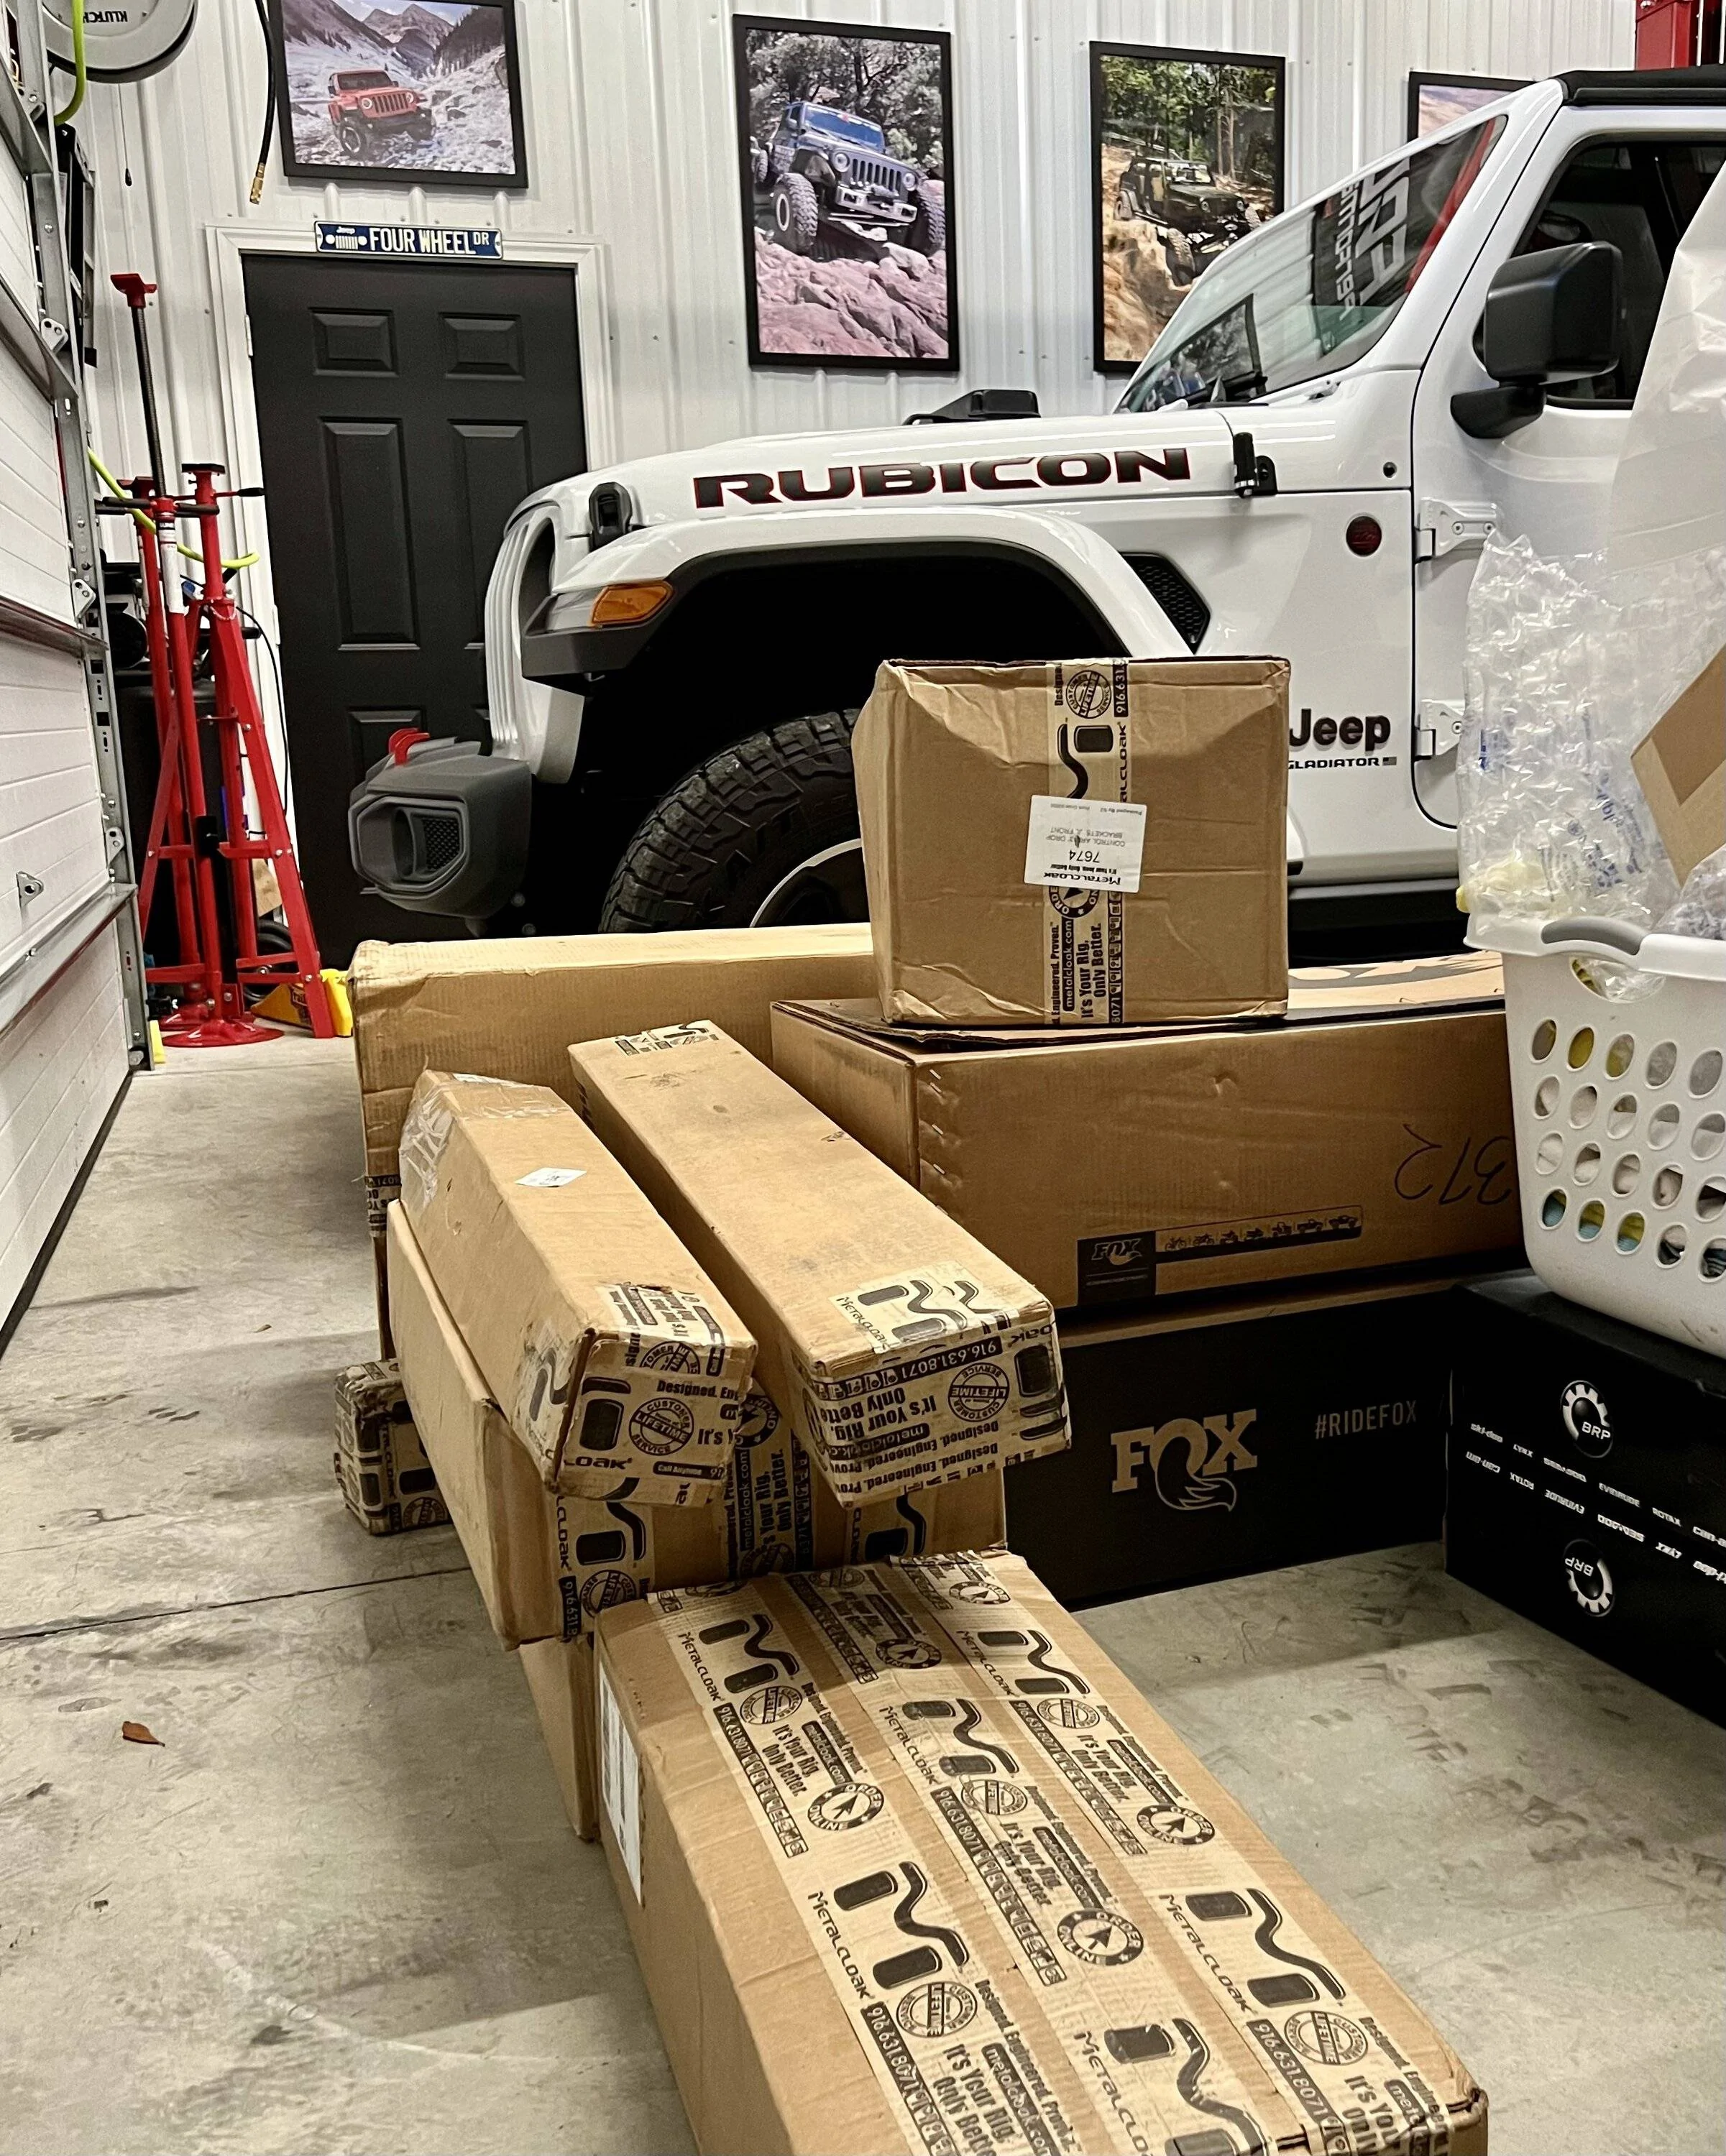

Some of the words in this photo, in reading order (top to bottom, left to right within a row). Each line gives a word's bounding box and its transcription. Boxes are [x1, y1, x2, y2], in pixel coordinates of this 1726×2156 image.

[369, 227, 415, 252] FOUR
[418, 229, 477, 255] WHEEL
[473, 232, 490, 246] DR
[692, 447, 1191, 509] RUBICON
[1289, 707, 1391, 752] Jeep
[1086, 829, 1123, 839] BRACKETS
[1093, 838, 1126, 847] CONTROL
[1069, 849, 1101, 863] 7674
[1075, 940, 1090, 965] Rig,
[1090, 922, 1104, 967] Better.
[1062, 920, 1073, 1008] metalcloak.com
[1078, 967, 1092, 997] Your
[1092, 969, 1107, 998] Only
[1080, 998, 1094, 1018] It's
[1091, 1238, 1143, 1264] FOX
[901, 1340, 997, 1379] 916.631.8071
[962, 1366, 1003, 1378] SERVICE
[656, 1379, 717, 1398] Designed.
[866, 1386, 906, 1413] Only
[950, 1387, 1007, 1398] LIFETIME
[868, 1406, 909, 1432] Your
[909, 1394, 937, 1416] It's
[952, 1398, 1001, 1422] CUSTOMER
[635, 1411, 691, 1443] LIFETIME
[939, 1420, 999, 1447] Designed.
[1314, 1399, 1418, 1440] #RIDEFOX
[1582, 1421, 1611, 1439] BRP
[697, 1427, 724, 1445] It's
[868, 1439, 937, 1470] Engineered.
[937, 1442, 999, 1470] Designed.
[1111, 1408, 1258, 1510] FOX
[863, 1460, 937, 1492] Engineered.
[1510, 1471, 1535, 1491] ROTAX
[739, 1451, 753, 1550] metalcloak.com
[759, 1502, 775, 1537] Your
[1564, 1557, 1594, 1577] BRP
[772, 1723, 794, 1741] It's
[782, 1736, 811, 1760] Your
[805, 1724, 847, 1785] metalcloak.com
[761, 1743, 787, 1766] Only
[775, 1761, 809, 1797] Better.
[845, 1783, 883, 1810] ORDER
[808, 1804, 848, 1832] ONLINE
[867, 2007, 924, 2093] 916.631.8071
[942, 2043, 970, 2071] It's
[1254, 2023, 1329, 2117] 916.631.8071
[1344, 2075, 1377, 2104] It's
